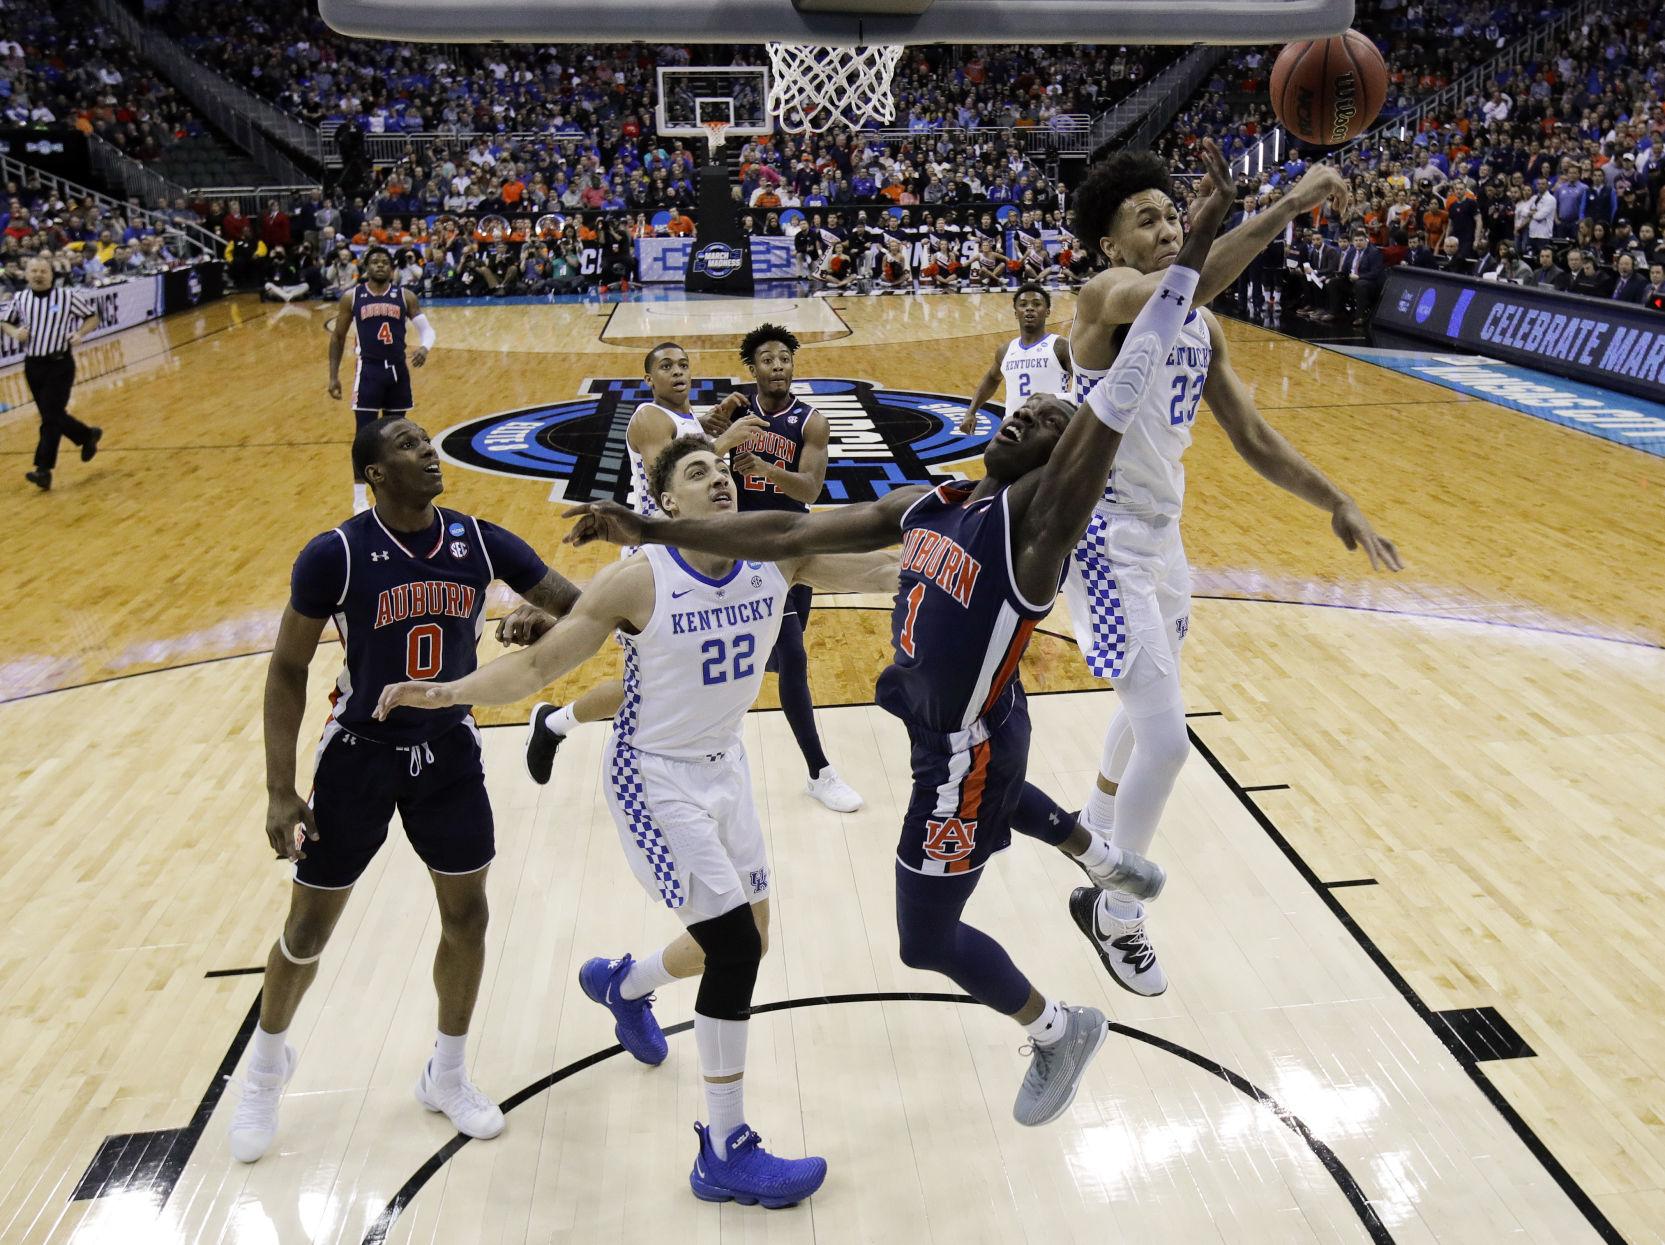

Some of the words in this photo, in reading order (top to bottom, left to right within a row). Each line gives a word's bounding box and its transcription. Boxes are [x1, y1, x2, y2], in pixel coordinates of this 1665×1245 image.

[1329, 72, 1358, 143] Wilson
[704, 252, 729, 260] MARCH
[707, 259, 741, 267] MADNESS
[360, 303, 401, 321] AUBURN
[377, 322, 394, 345] 4
[1480, 302, 1610, 366] CELEBRATE
[1005, 357, 1049, 371] KENTUCKY
[1018, 372, 1031, 397] 2
[1170, 374, 1205, 426] 23
[484, 421, 545, 445] ELITE
[487, 443, 530, 452] 8
[450, 541, 469, 558] SEC
[900, 527, 982, 610] UBURN
[374, 581, 476, 630] AUBURN
[671, 596, 774, 635] KENTUCKY
[900, 581, 927, 659] 1
[405, 622, 443, 681] 0
[701, 633, 756, 686] 22
